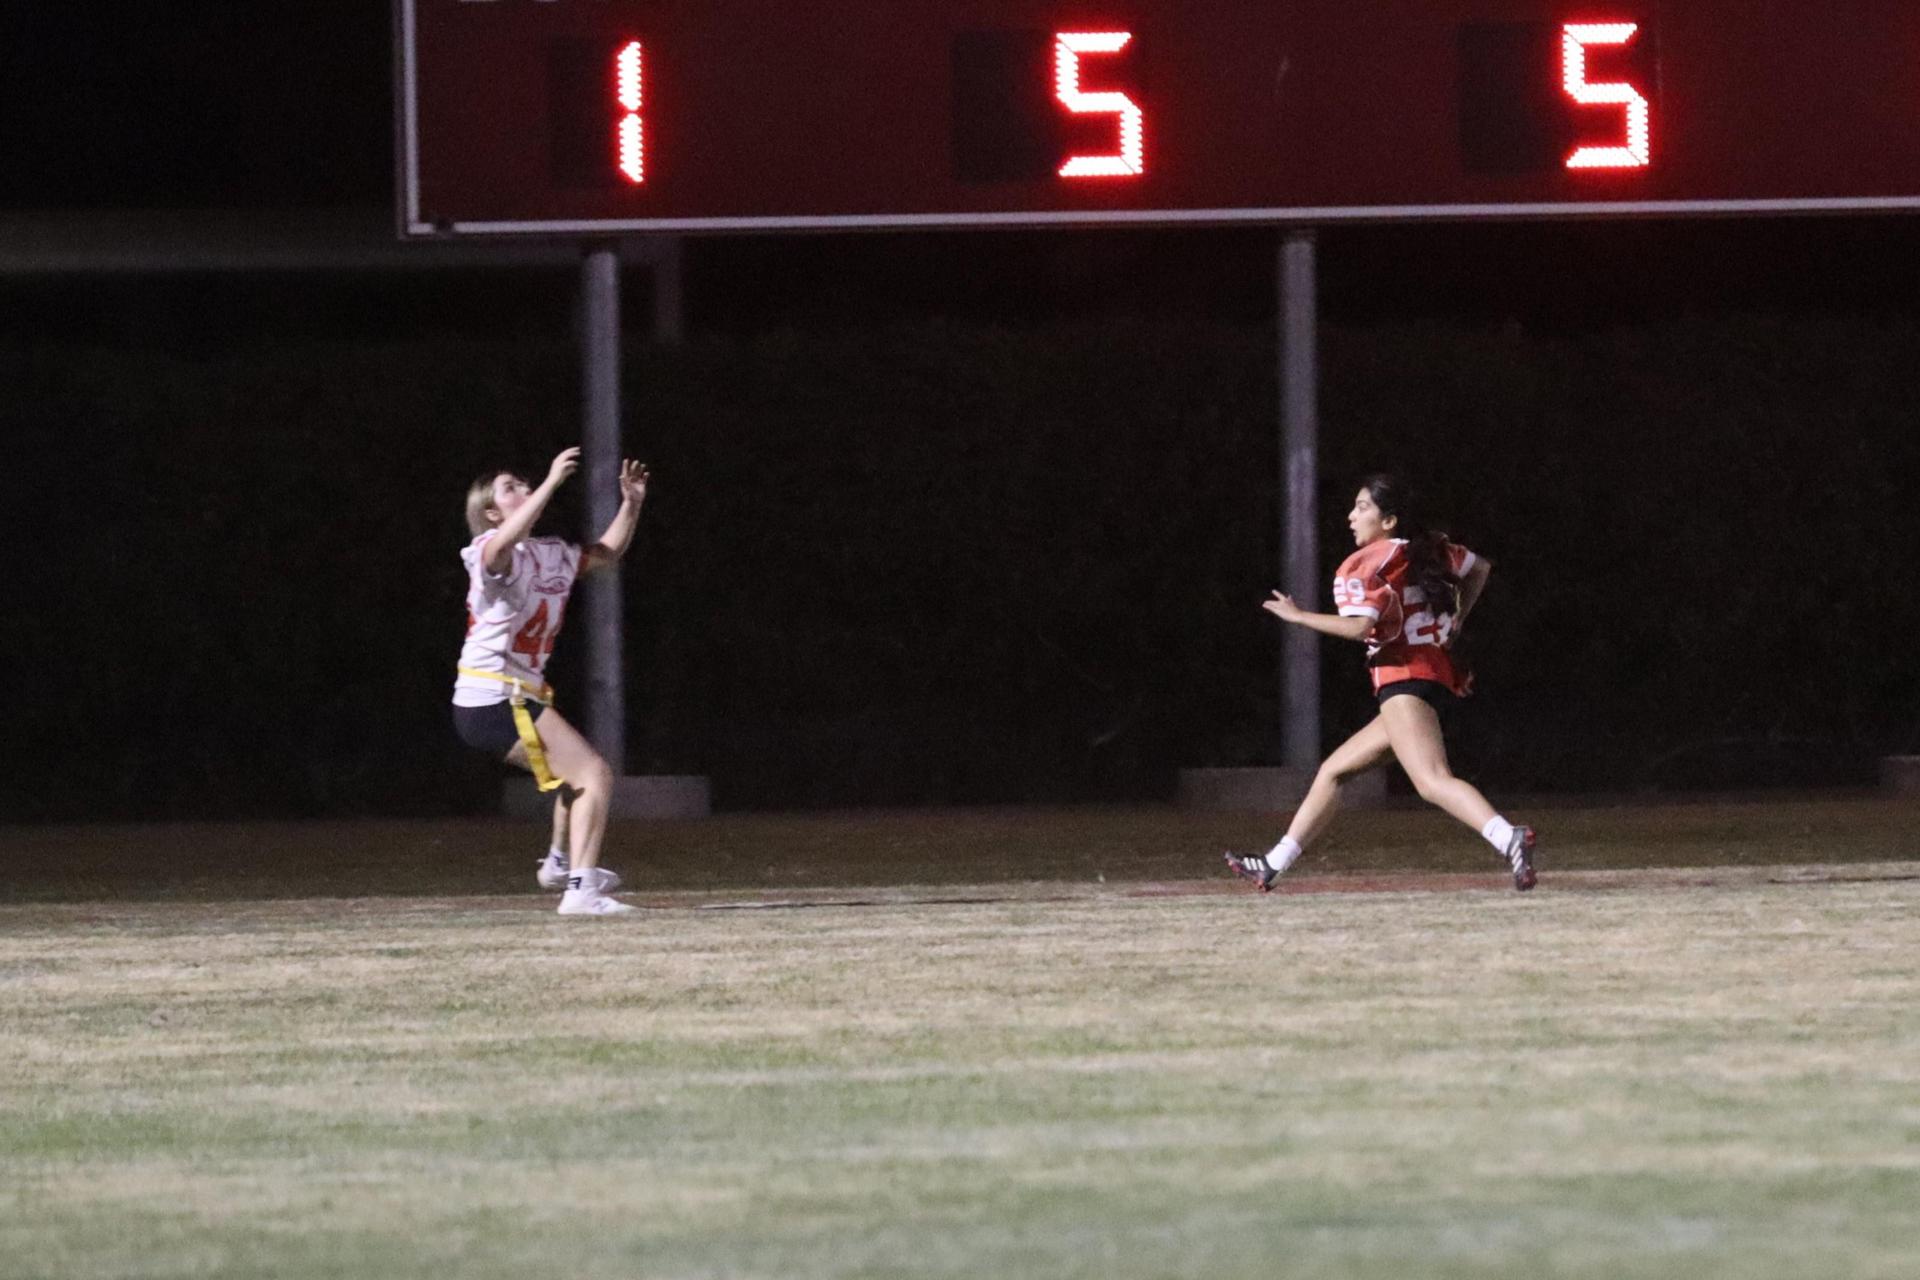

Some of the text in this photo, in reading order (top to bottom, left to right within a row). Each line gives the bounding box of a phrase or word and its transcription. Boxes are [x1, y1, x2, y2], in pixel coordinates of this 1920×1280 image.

[617, 41, 643, 182] 1
[1055, 32, 1143, 176] 5
[1563, 23, 1649, 167] 5
[511, 597, 567, 668] 4
